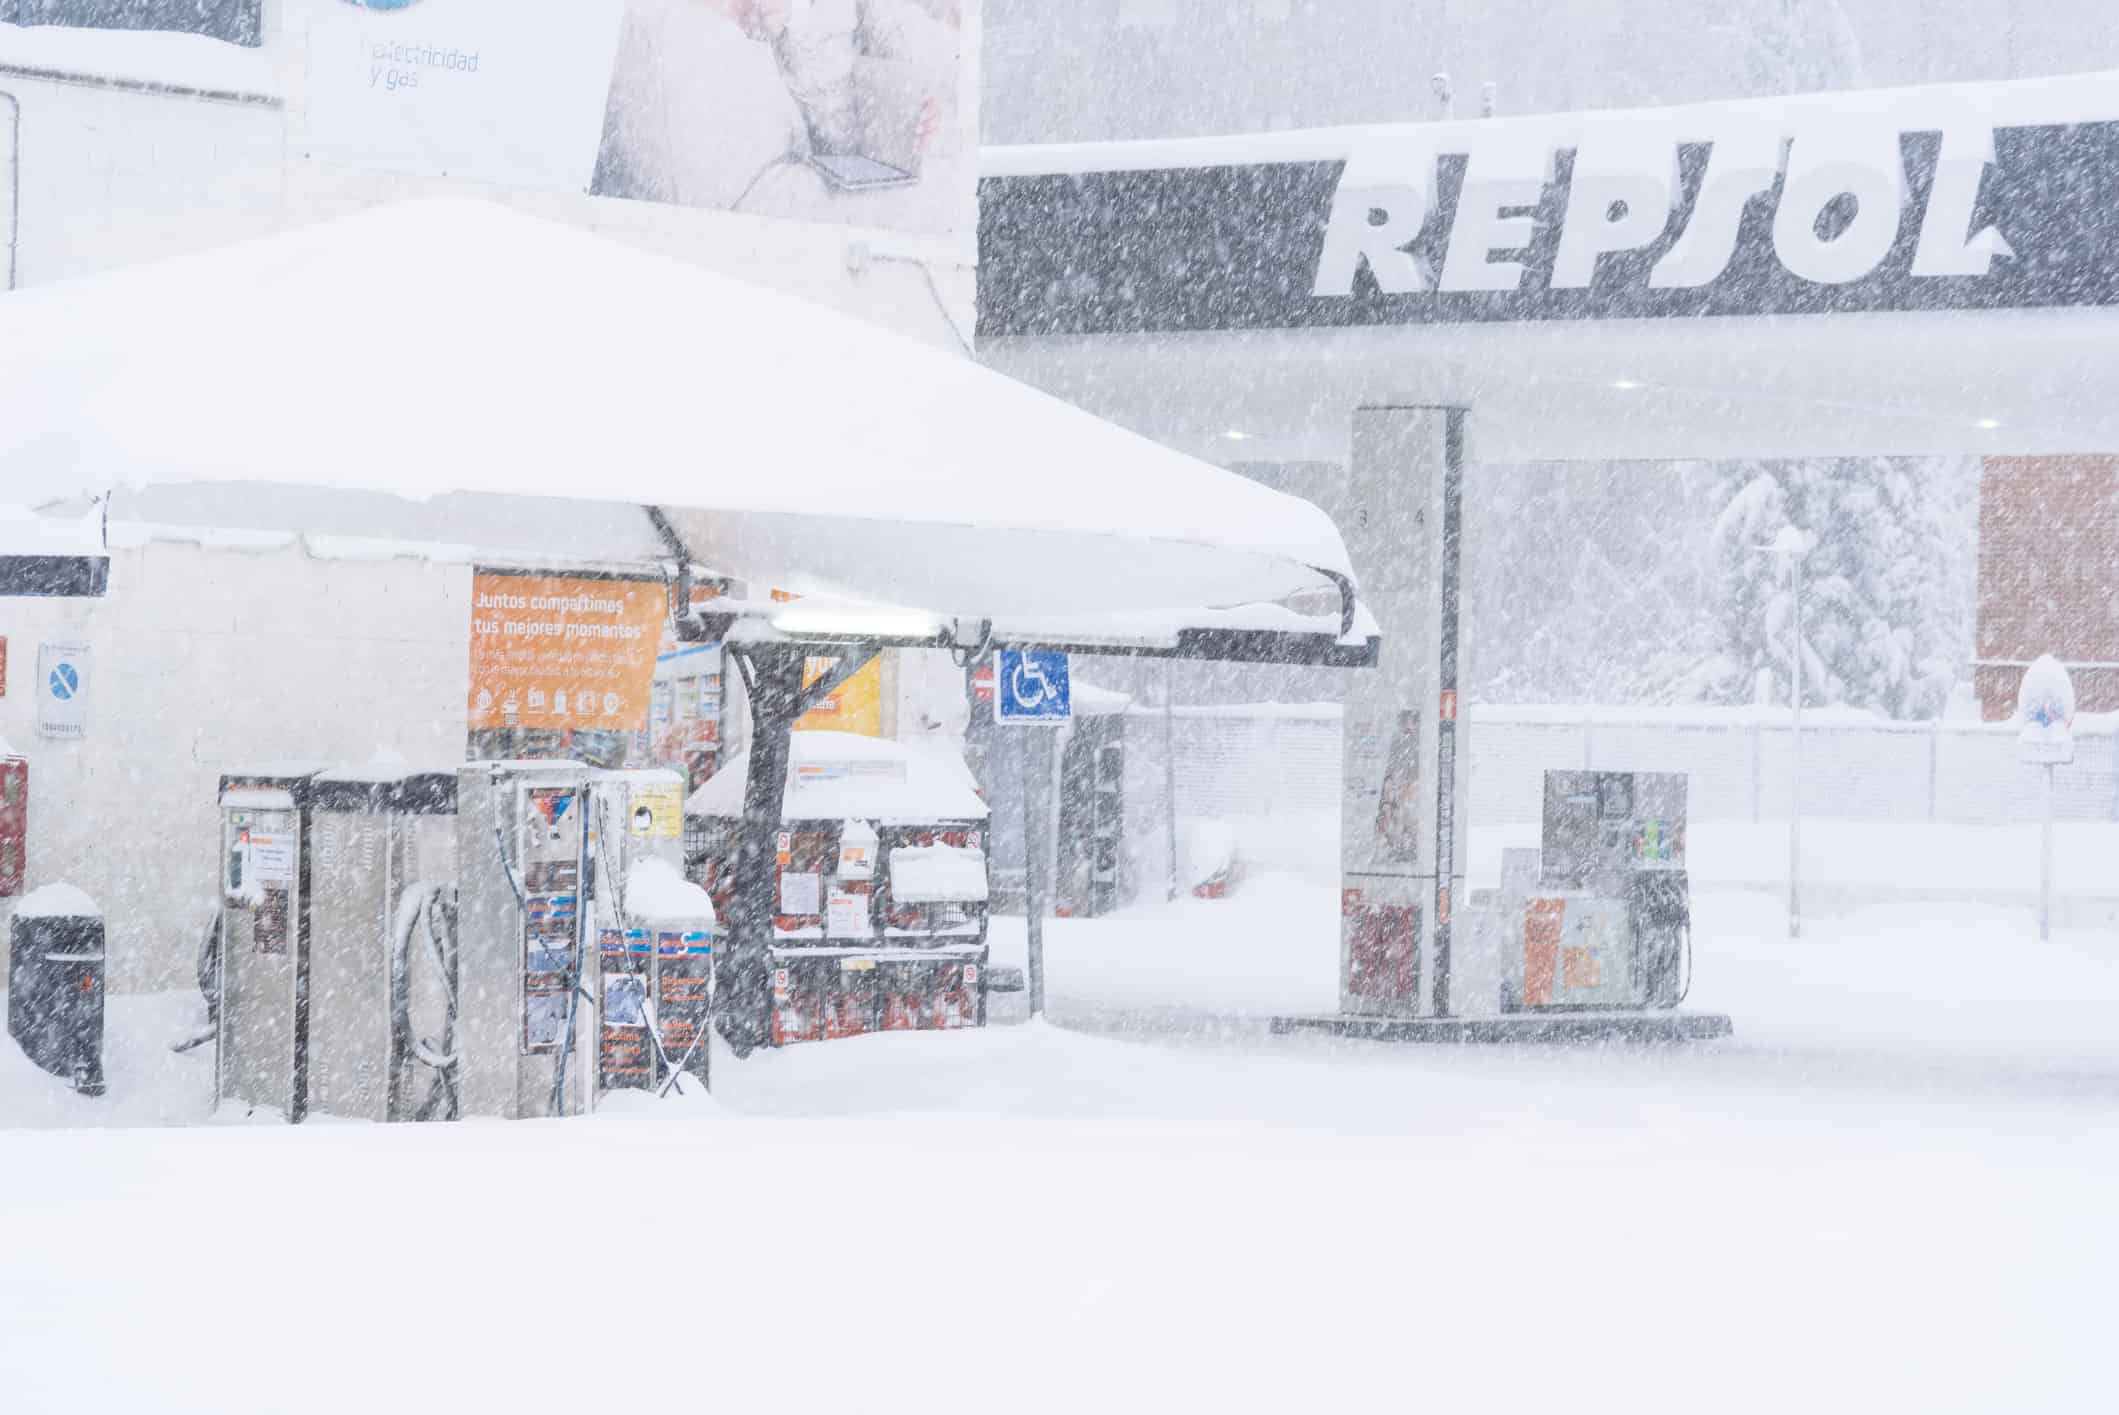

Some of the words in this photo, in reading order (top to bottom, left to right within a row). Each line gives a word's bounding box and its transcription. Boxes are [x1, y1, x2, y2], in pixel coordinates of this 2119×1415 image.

[368, 64, 383, 88] y
[386, 69, 418, 91] gas
[1311, 152, 2014, 297] REPSOL
[1414, 508, 1424, 528] 4
[476, 592, 526, 609] Juntos
[531, 594, 625, 615] compartimos
[473, 619, 499, 634] tus
[504, 618, 561, 639] mejores
[566, 623, 642, 640] momentos
